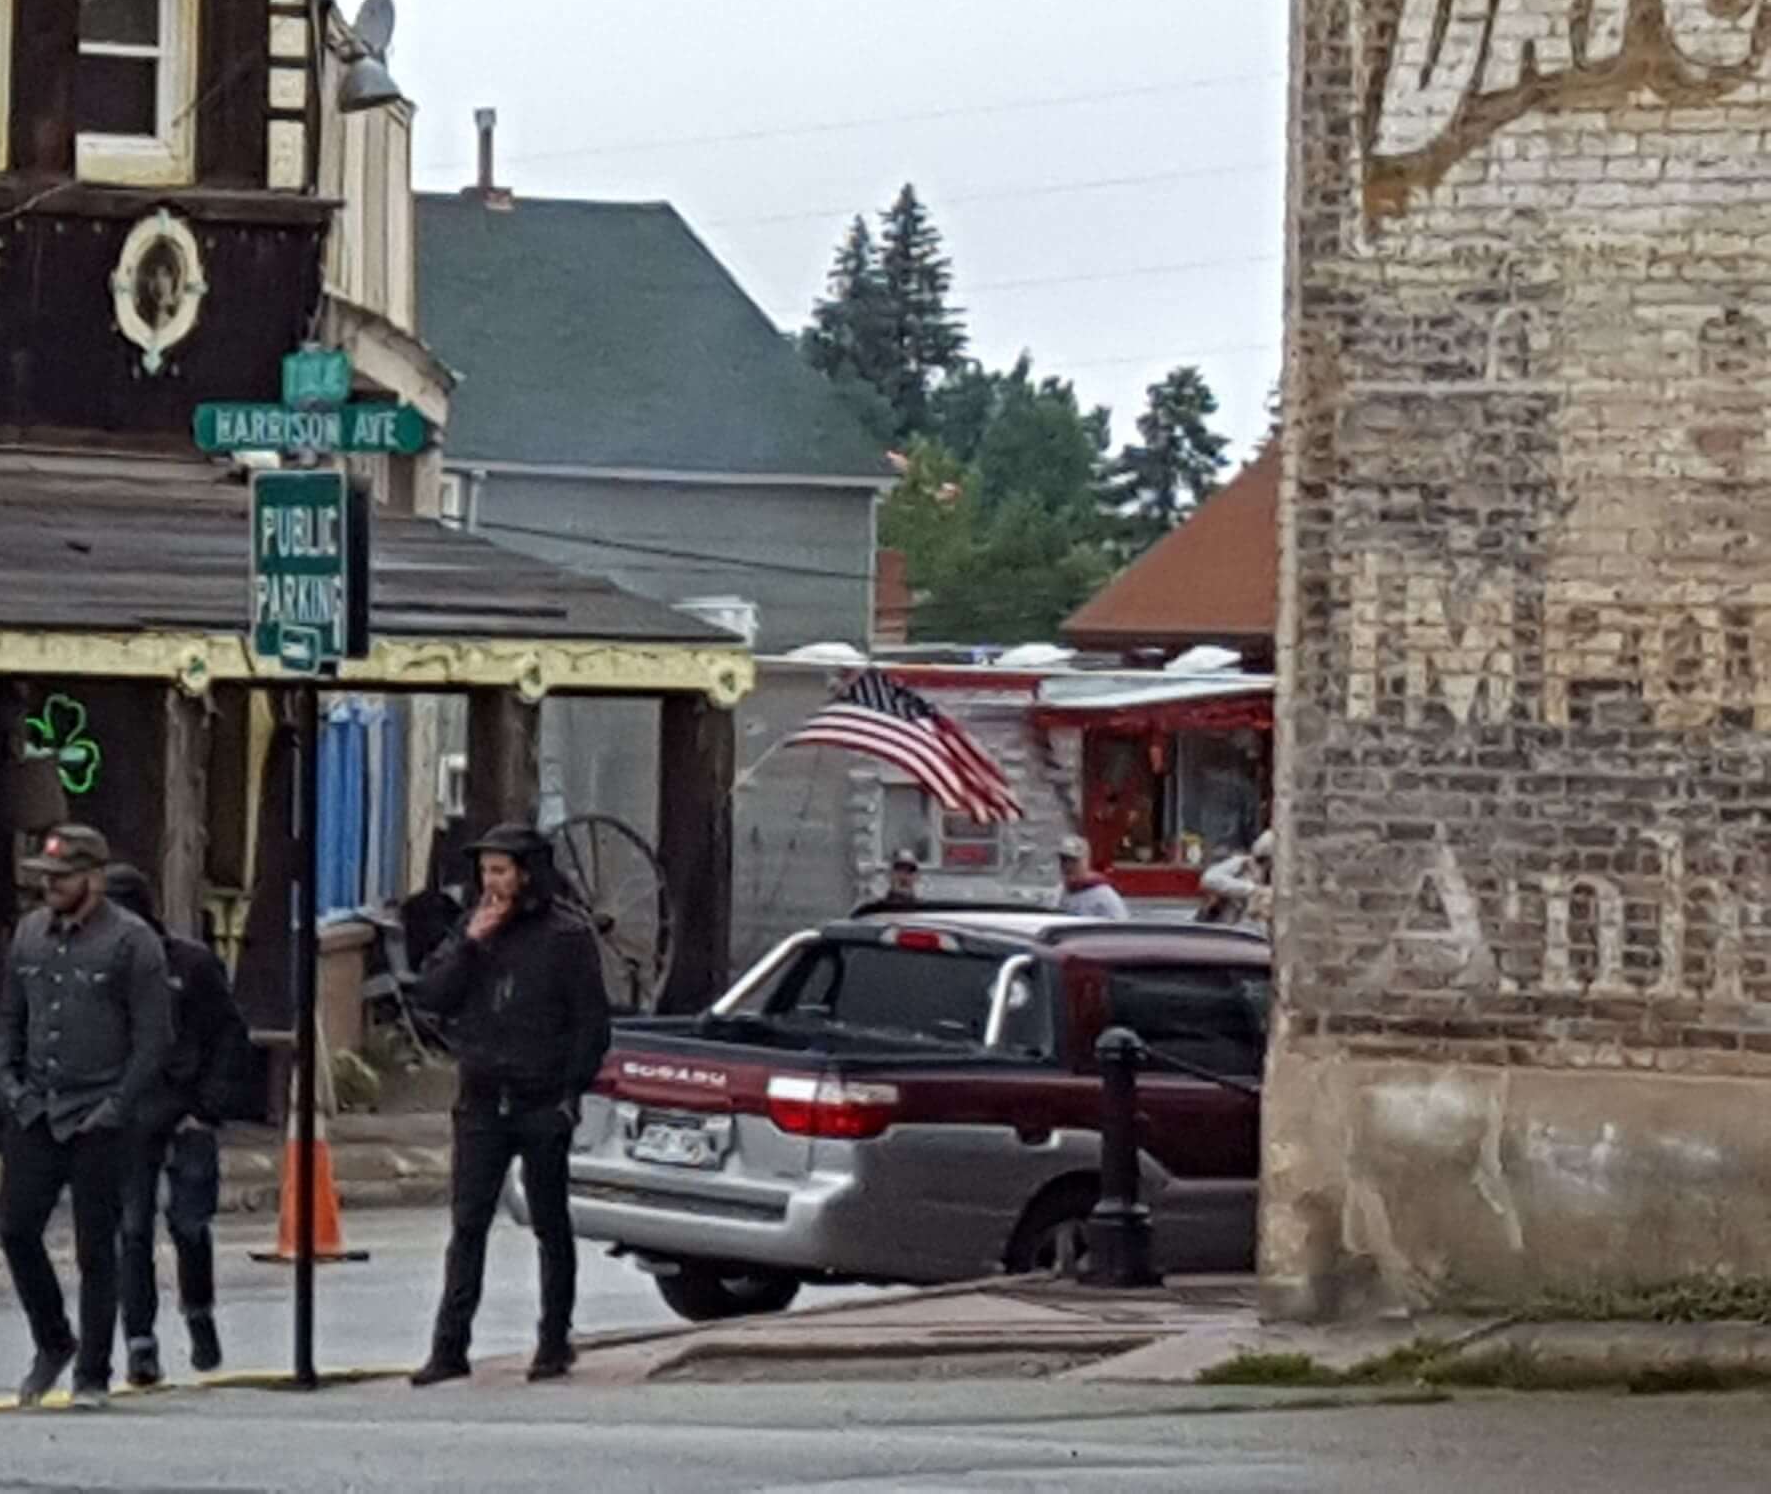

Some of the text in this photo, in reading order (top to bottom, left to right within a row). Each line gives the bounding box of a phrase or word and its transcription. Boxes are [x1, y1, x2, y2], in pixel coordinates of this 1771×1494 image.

[215, 409, 399, 445] HARRISON AVE
[262, 508, 337, 556] PUBLIC
